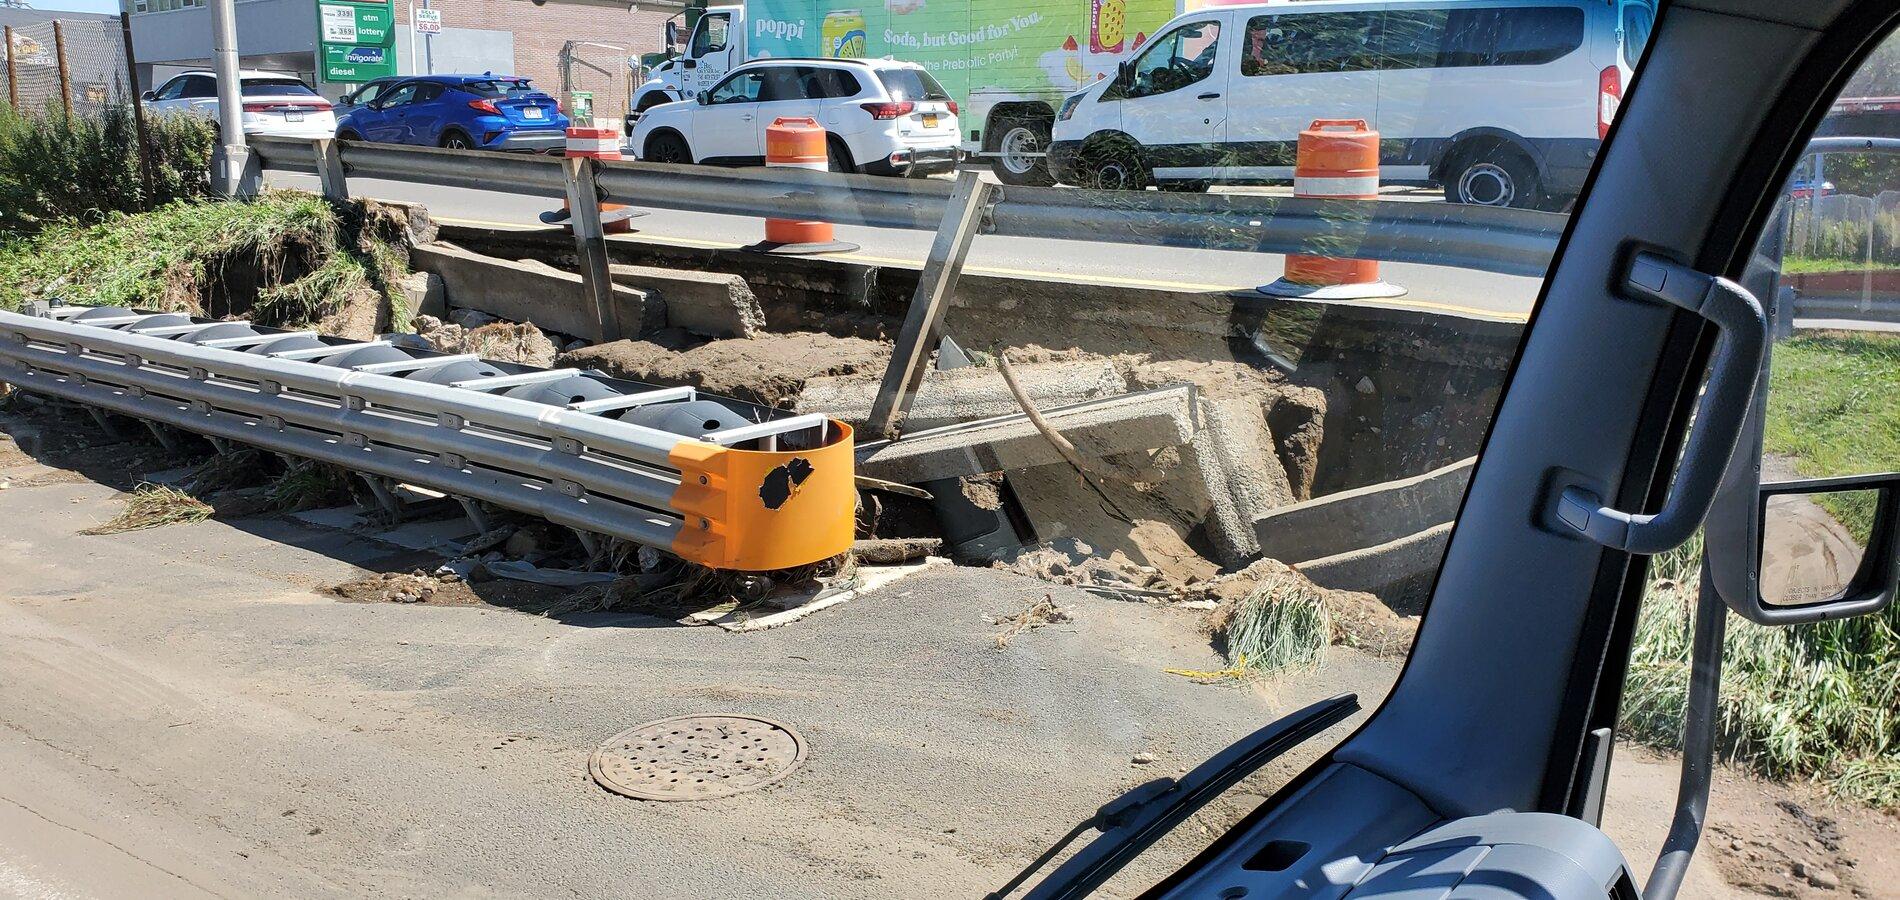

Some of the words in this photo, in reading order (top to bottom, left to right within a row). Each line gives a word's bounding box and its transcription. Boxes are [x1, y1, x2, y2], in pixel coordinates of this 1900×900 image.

[358, 26, 385, 37] lottery
[755, 19, 805, 41] poppi
[883, 29, 921, 49] Soda,
[923, 32, 946, 47] but
[948, 26, 985, 46] Good
[987, 24, 1010, 40] for
[1010, 12, 1044, 32] You.
[345, 53, 384, 63] invigorate
[924, 59, 941, 71] the
[942, 56, 986, 70] Prebotic
[988, 44, 1019, 64] Party!
[330, 67, 355, 76] diesel
